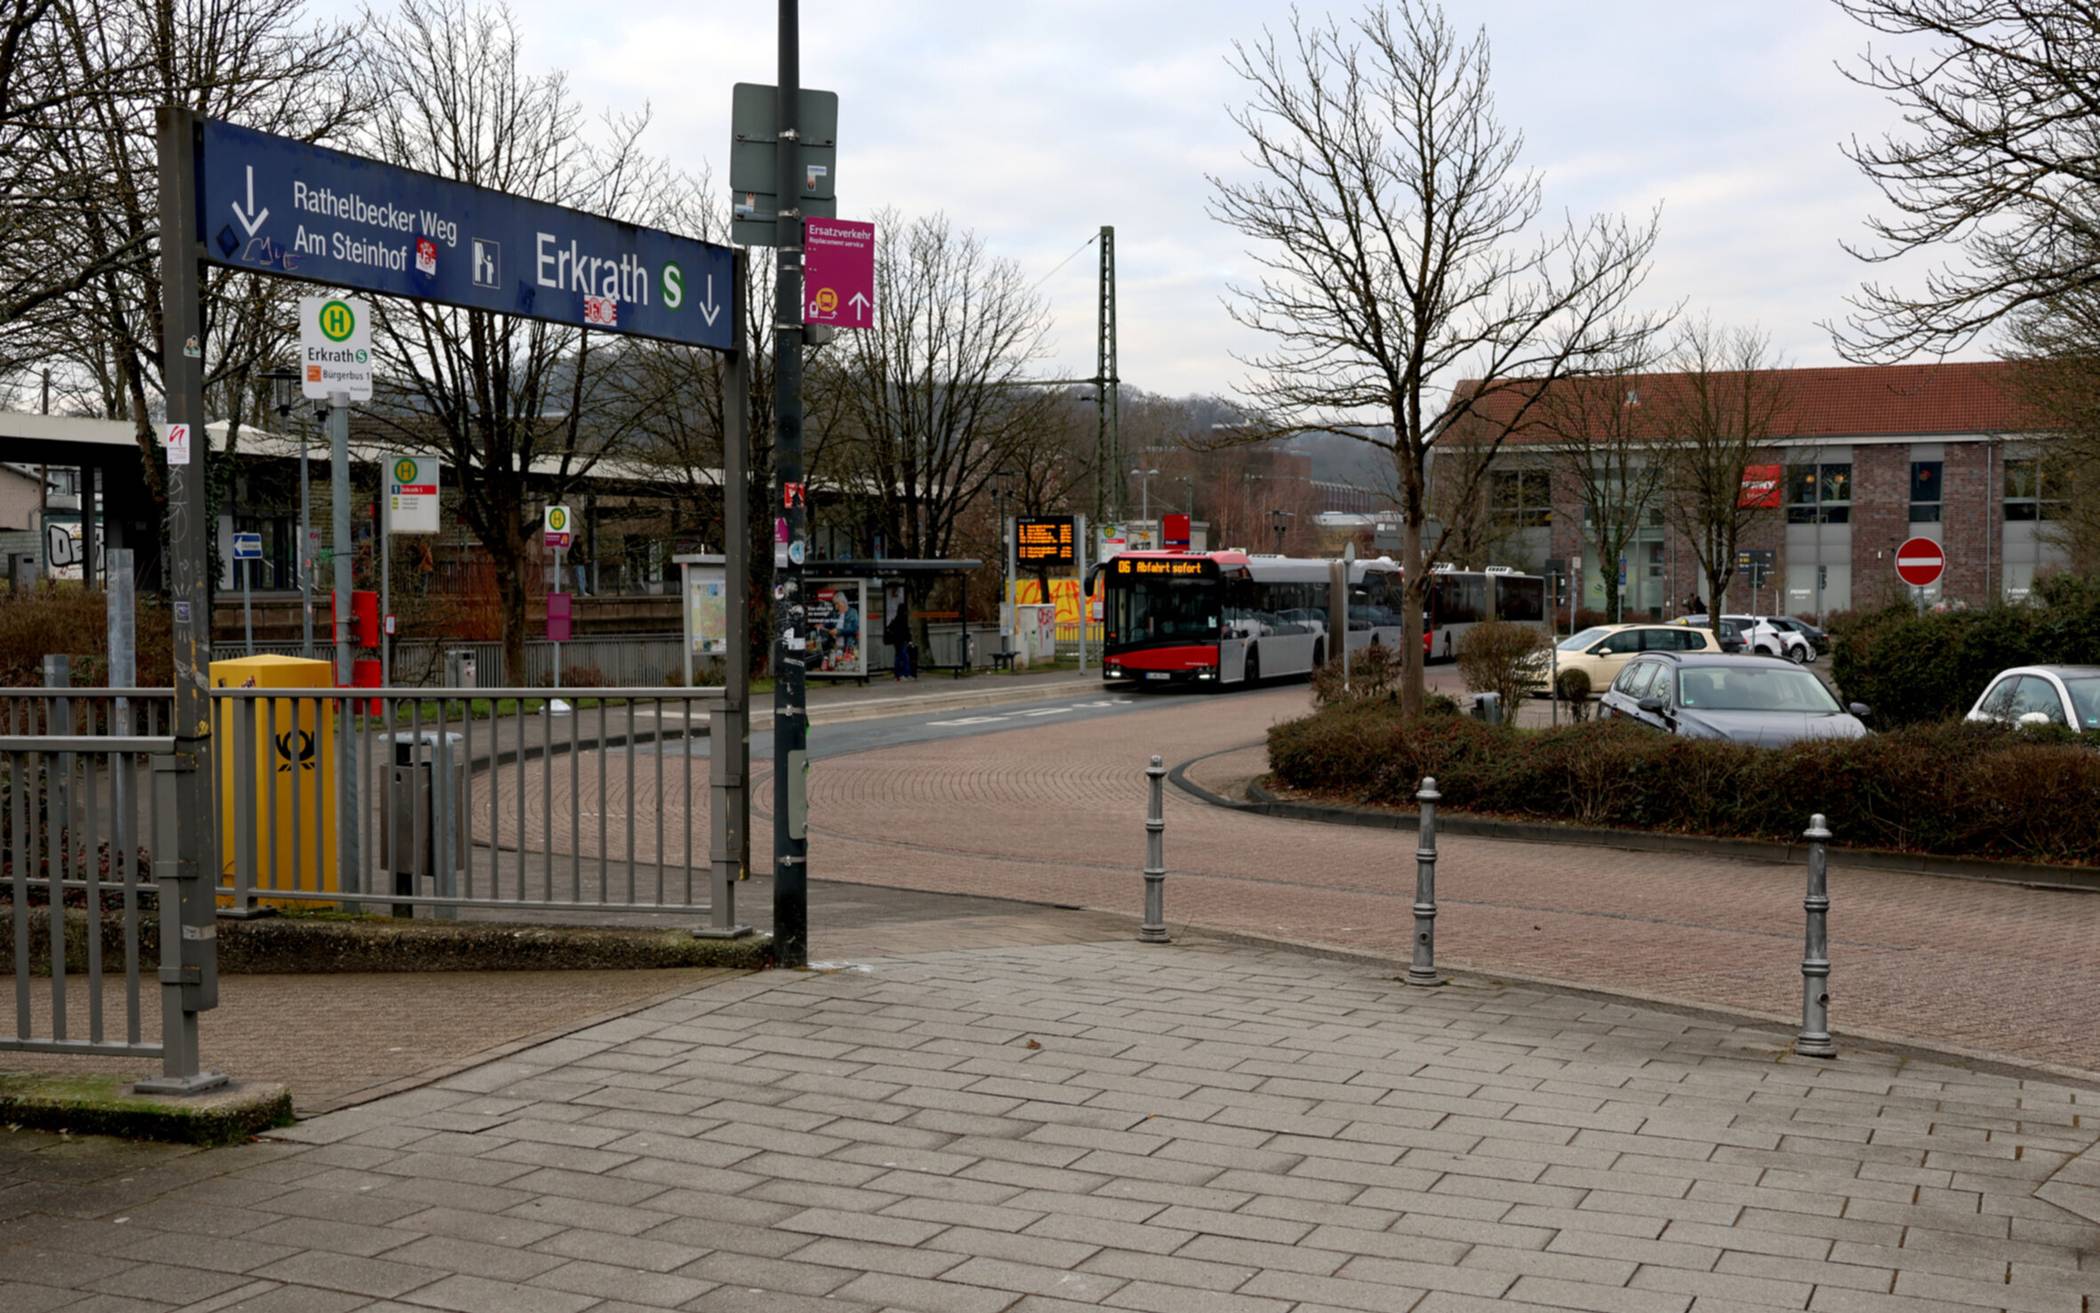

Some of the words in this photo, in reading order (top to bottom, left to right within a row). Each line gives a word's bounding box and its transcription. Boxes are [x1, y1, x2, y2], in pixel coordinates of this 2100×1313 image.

[294, 181, 415, 233] Rathelbecker
[420, 210, 457, 248] Weg
[809, 224, 872, 240] Ersatzverkehr
[294, 225, 326, 257] Am
[332, 232, 407, 272] Steinhof
[809, 236, 843, 247] Replacement
[844, 241, 864, 249] service
[537, 232, 648, 306] Erkrath
[663, 265, 682, 308] S
[330, 310, 345, 333] H
[308, 346, 354, 363] Erkrath
[401, 463, 412, 478] H
[1136, 561, 1170, 573] Abfahrt
[1172, 562, 1201, 573] sofort
